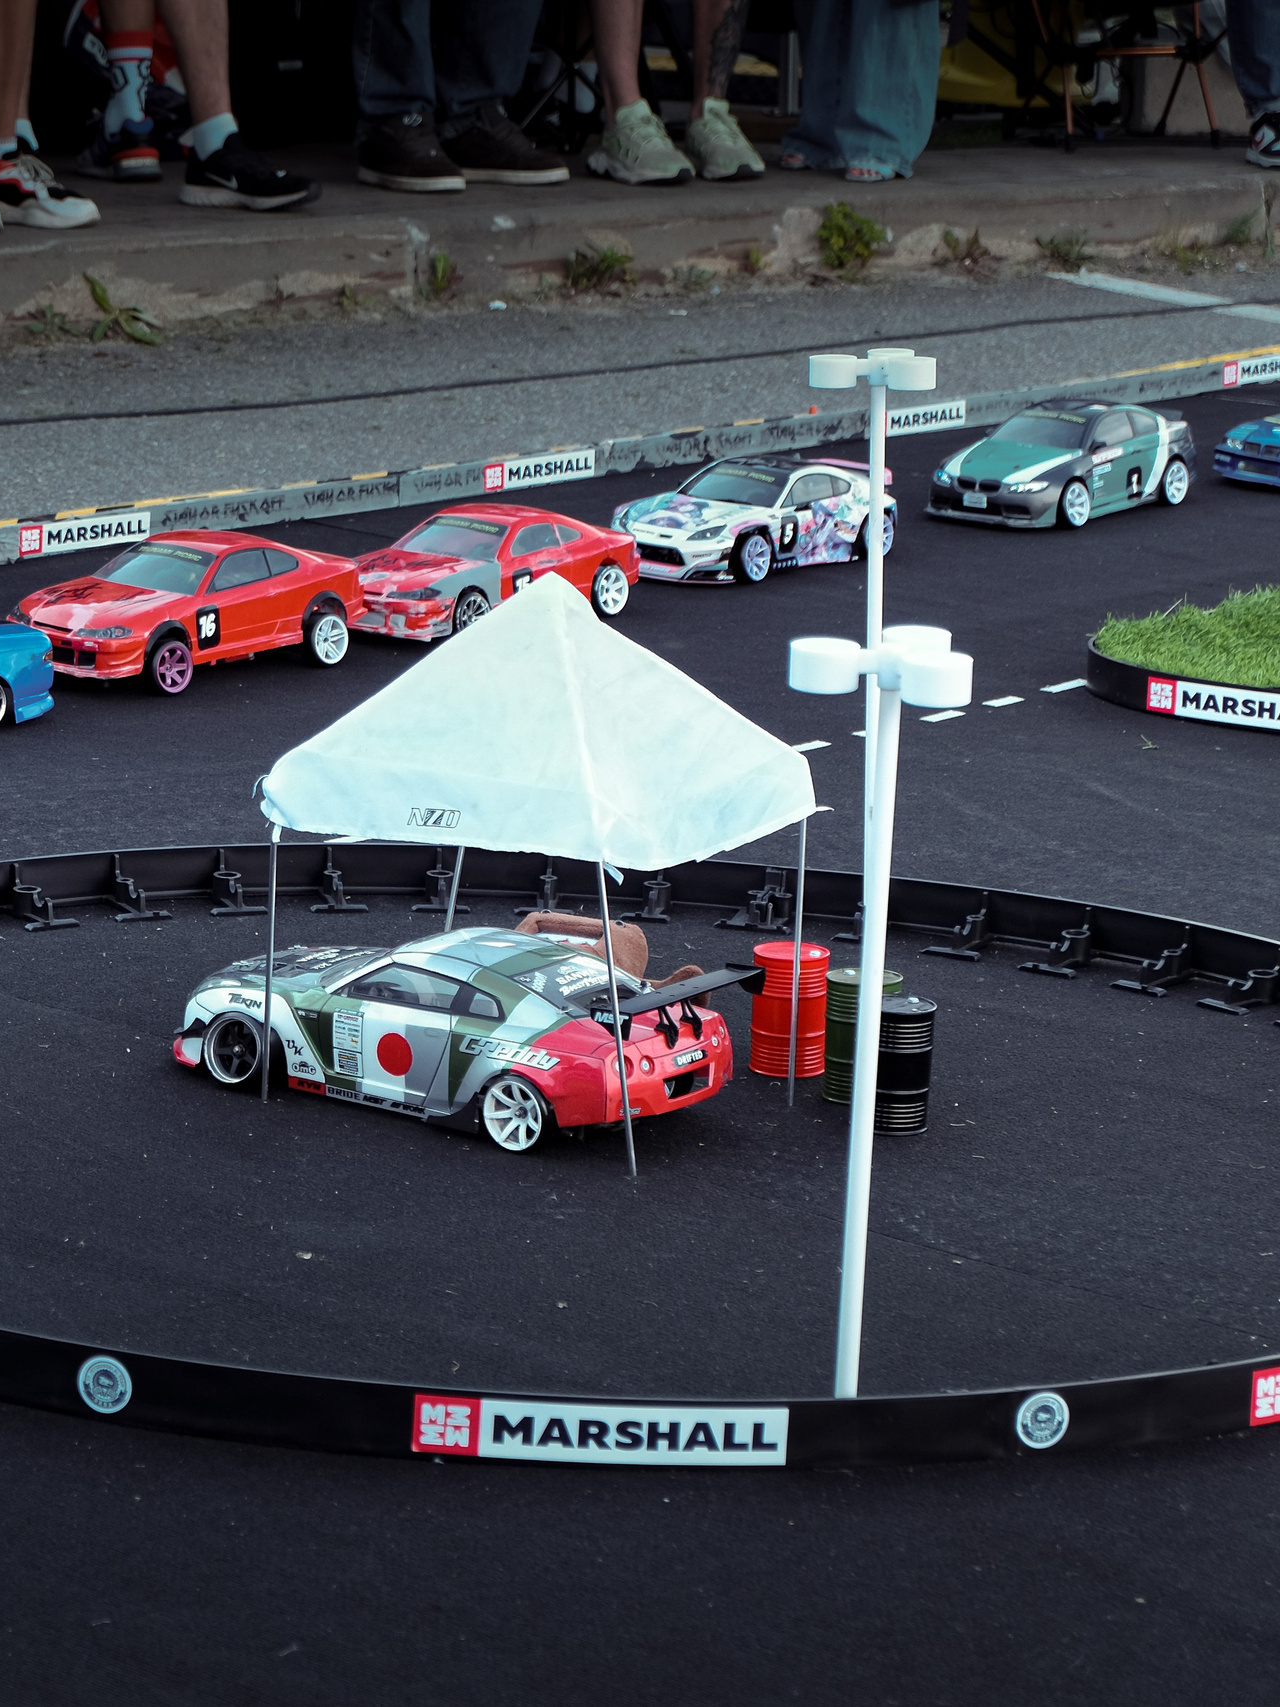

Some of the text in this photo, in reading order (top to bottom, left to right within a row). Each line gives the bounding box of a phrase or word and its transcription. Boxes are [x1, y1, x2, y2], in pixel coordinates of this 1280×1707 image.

[891, 408, 963, 430] MARSHALL
[508, 457, 592, 481] MARSHALL
[47, 519, 147, 546] MARSHALL
[782, 523, 794, 546] 5
[198, 613, 217, 640] 16
[676, 1050, 703, 1065] DRIFTED
[327, 1086, 361, 1100] BRIDE
[492, 1414, 779, 1452] MARSHALL
